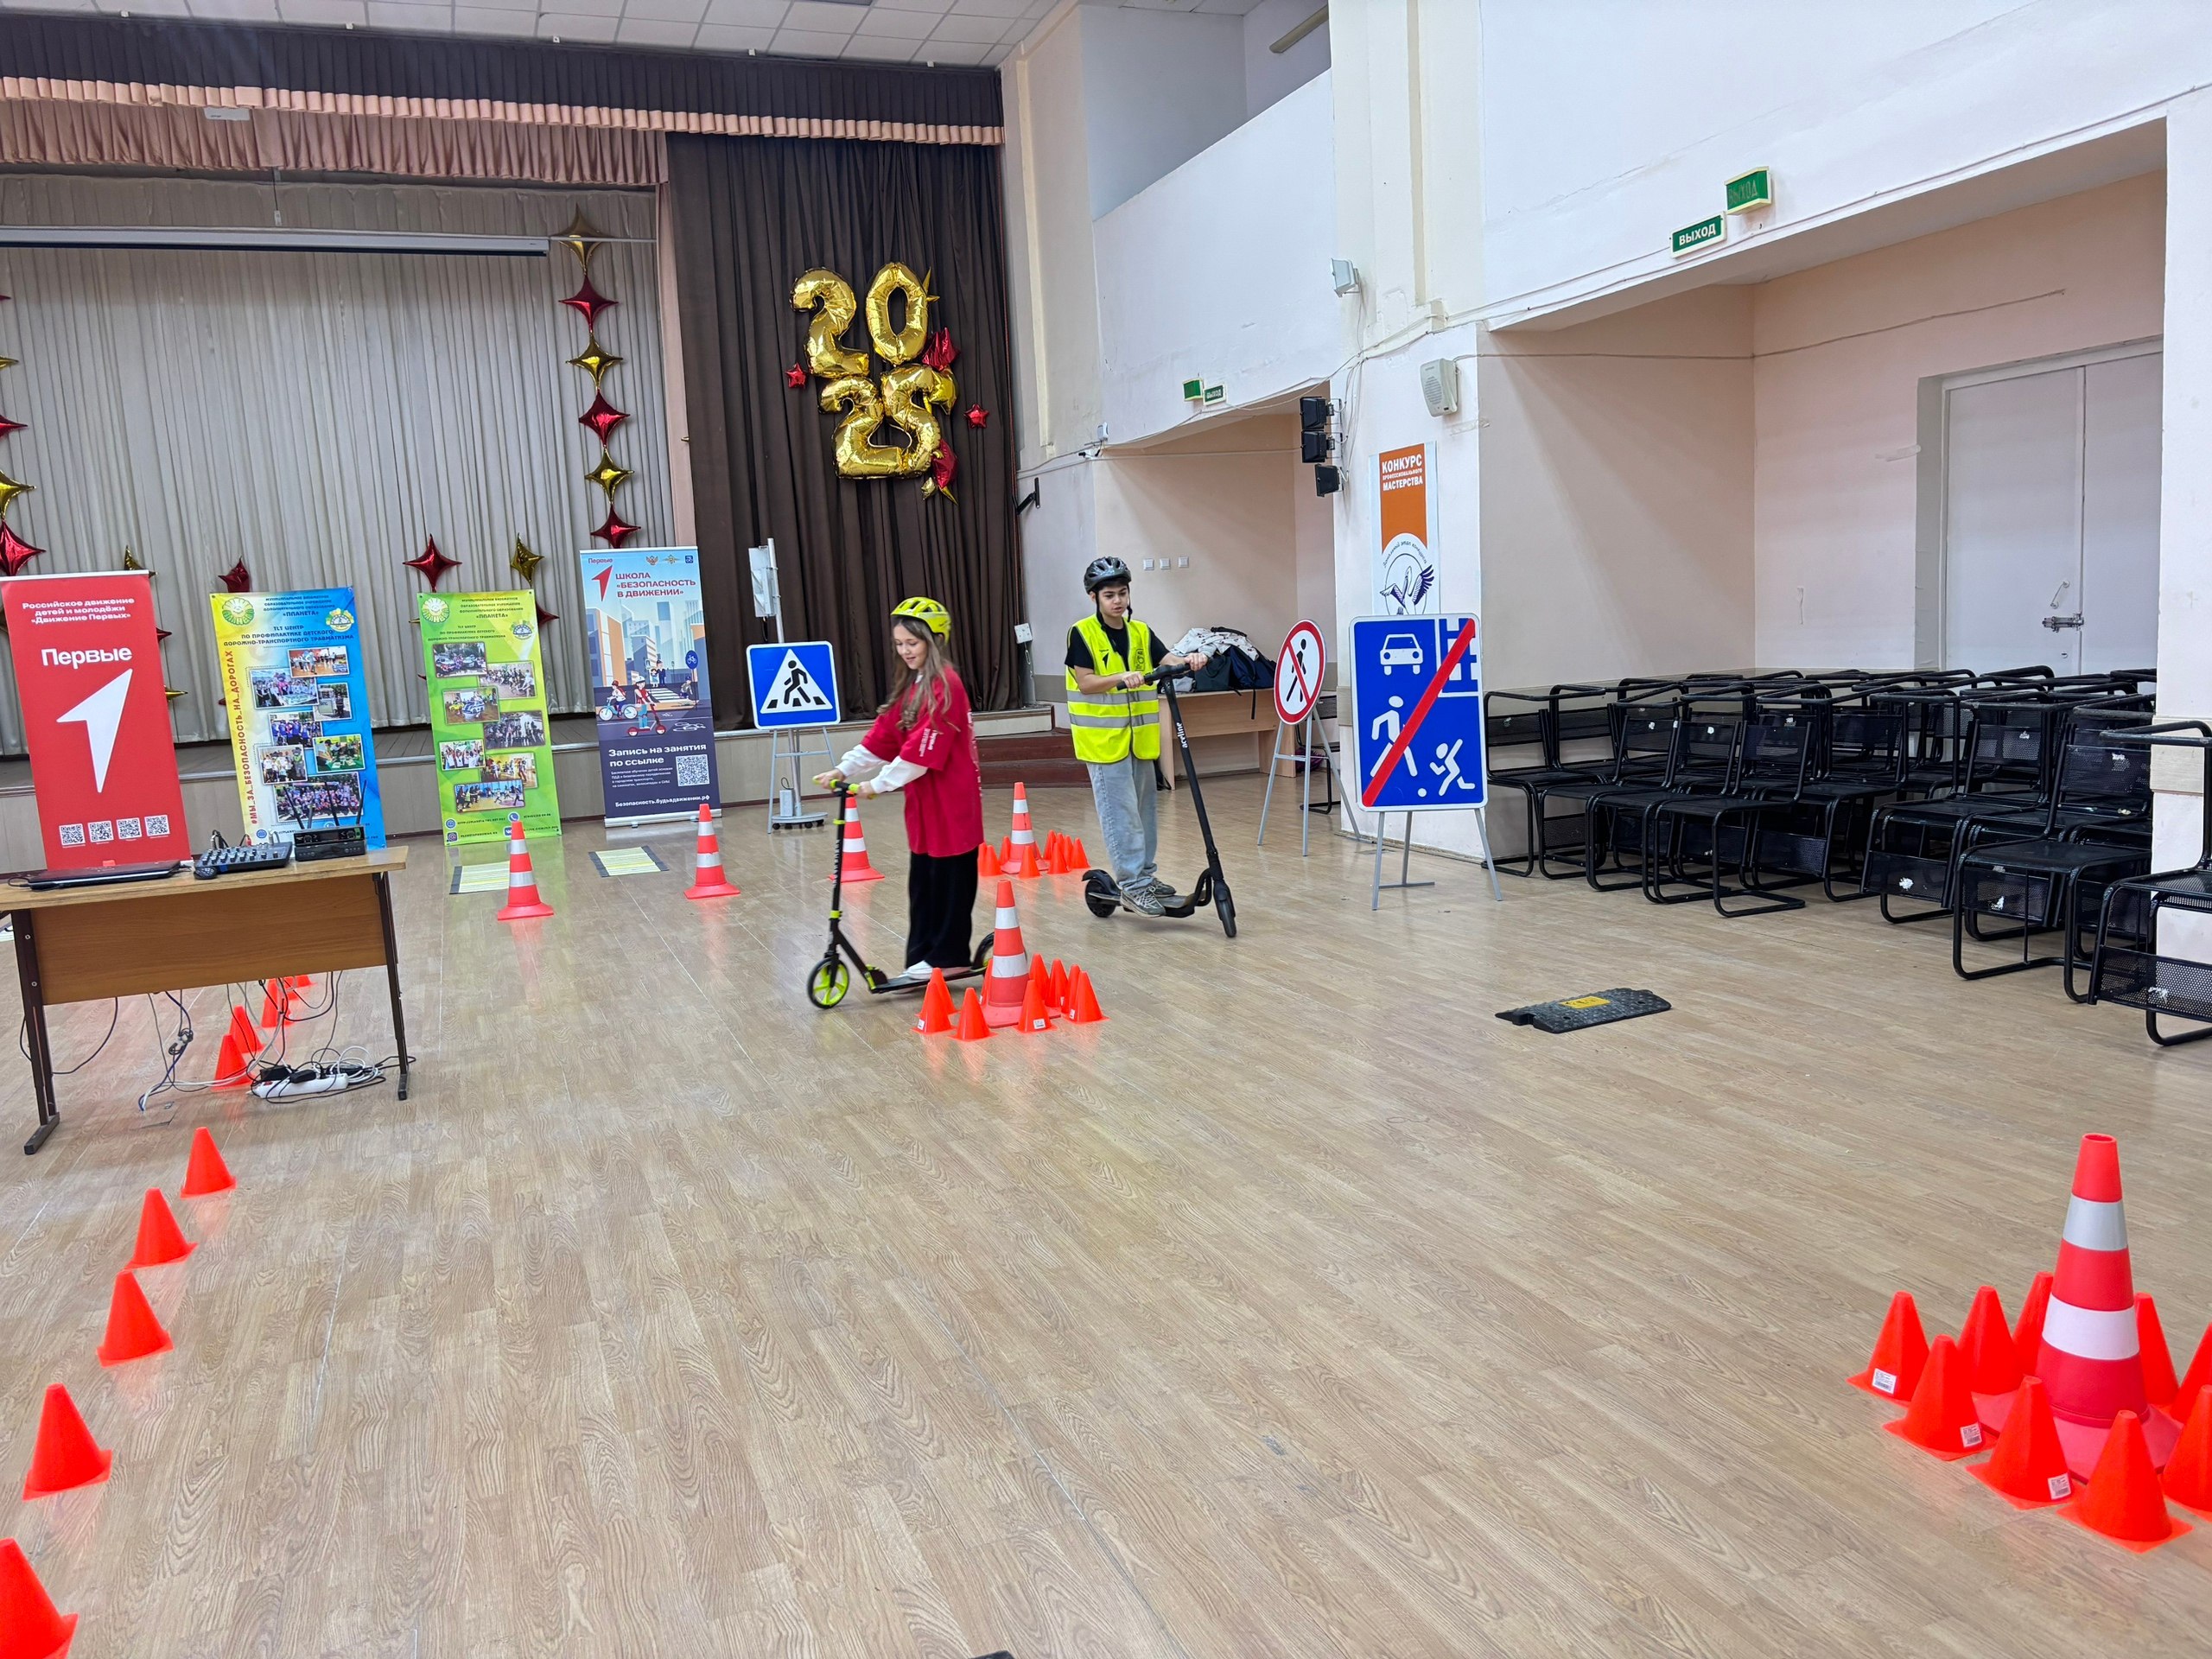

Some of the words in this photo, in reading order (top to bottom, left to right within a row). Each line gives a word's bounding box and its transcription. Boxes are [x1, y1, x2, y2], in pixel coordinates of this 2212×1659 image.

[1679, 223, 1716, 246] ВЫХОД
[1382, 454, 1422, 474] КОНКУРС
[1382, 475, 1424, 492] МАСТЕРСТВА
[616, 580, 696, 588] «БЕЗОПАСНОСТЬ
[625, 588, 683, 598] ДВИЖЕНИИ»
[22, 601, 84, 610] Российское
[85, 598, 136, 607] движение
[35, 607, 65, 617] детей
[74, 606, 126, 614] молодёжи
[31, 614, 88, 625] «Движение
[88, 612, 131, 622] Первых»
[223, 637, 309, 646] ДОРОЖНО-ТРАНСПОРТНОГО
[41, 647, 133, 670] Первые
[1176, 721, 1188, 748] aceline
[608, 748, 648, 757] Запись
[664, 744, 707, 753] занятия
[625, 757, 664, 766] ссылке
